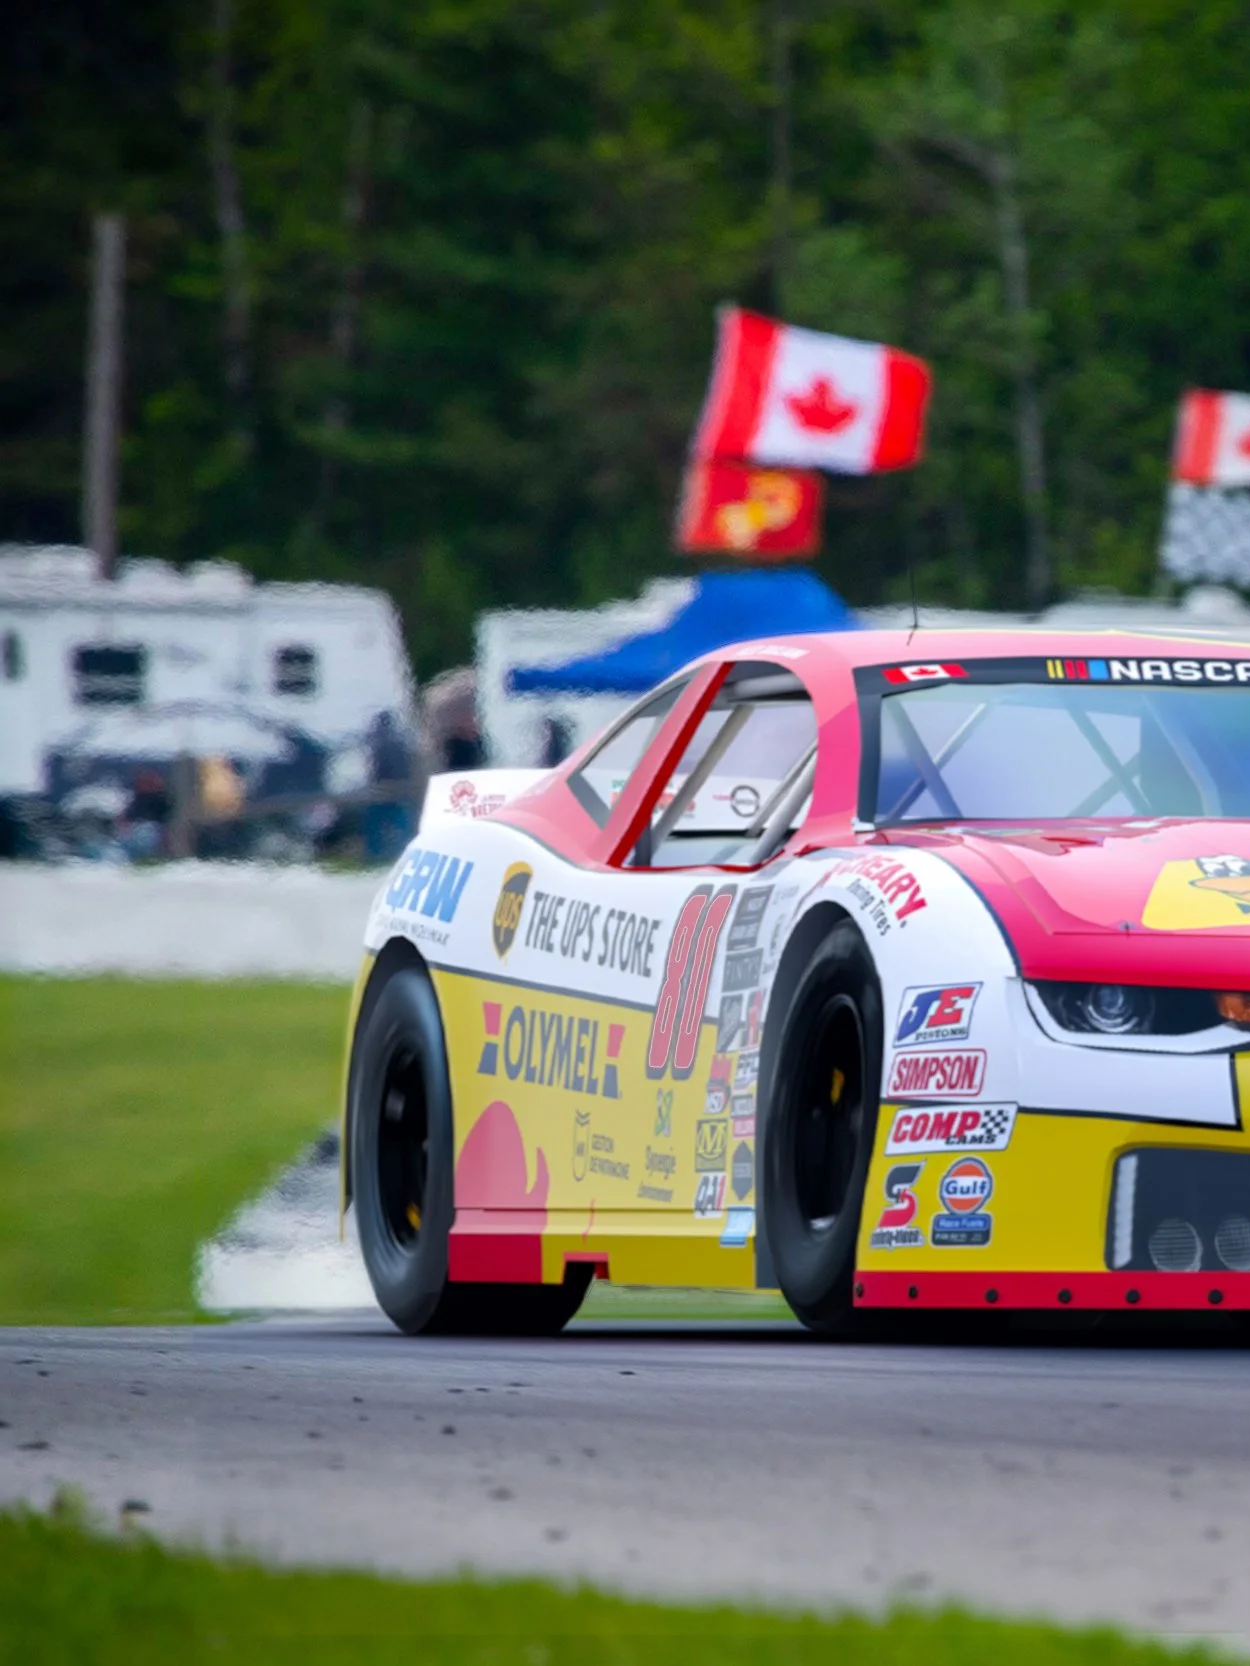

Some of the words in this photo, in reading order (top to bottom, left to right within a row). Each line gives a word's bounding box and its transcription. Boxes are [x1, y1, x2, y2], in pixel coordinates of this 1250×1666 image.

[524, 890, 567, 954] THE
[559, 899, 602, 963] UPS
[597, 908, 663, 978] STORE
[646, 884, 738, 1079] 80
[897, 986, 976, 1042] JE
[503, 1005, 599, 1096] OLYMEL
[914, 1026, 967, 1042] PISTONS
[893, 1055, 980, 1092] SIMPSON
[892, 1110, 982, 1144] COMP
[944, 1133, 998, 1146] CAMS
[945, 1180, 987, 1196] Gulf
